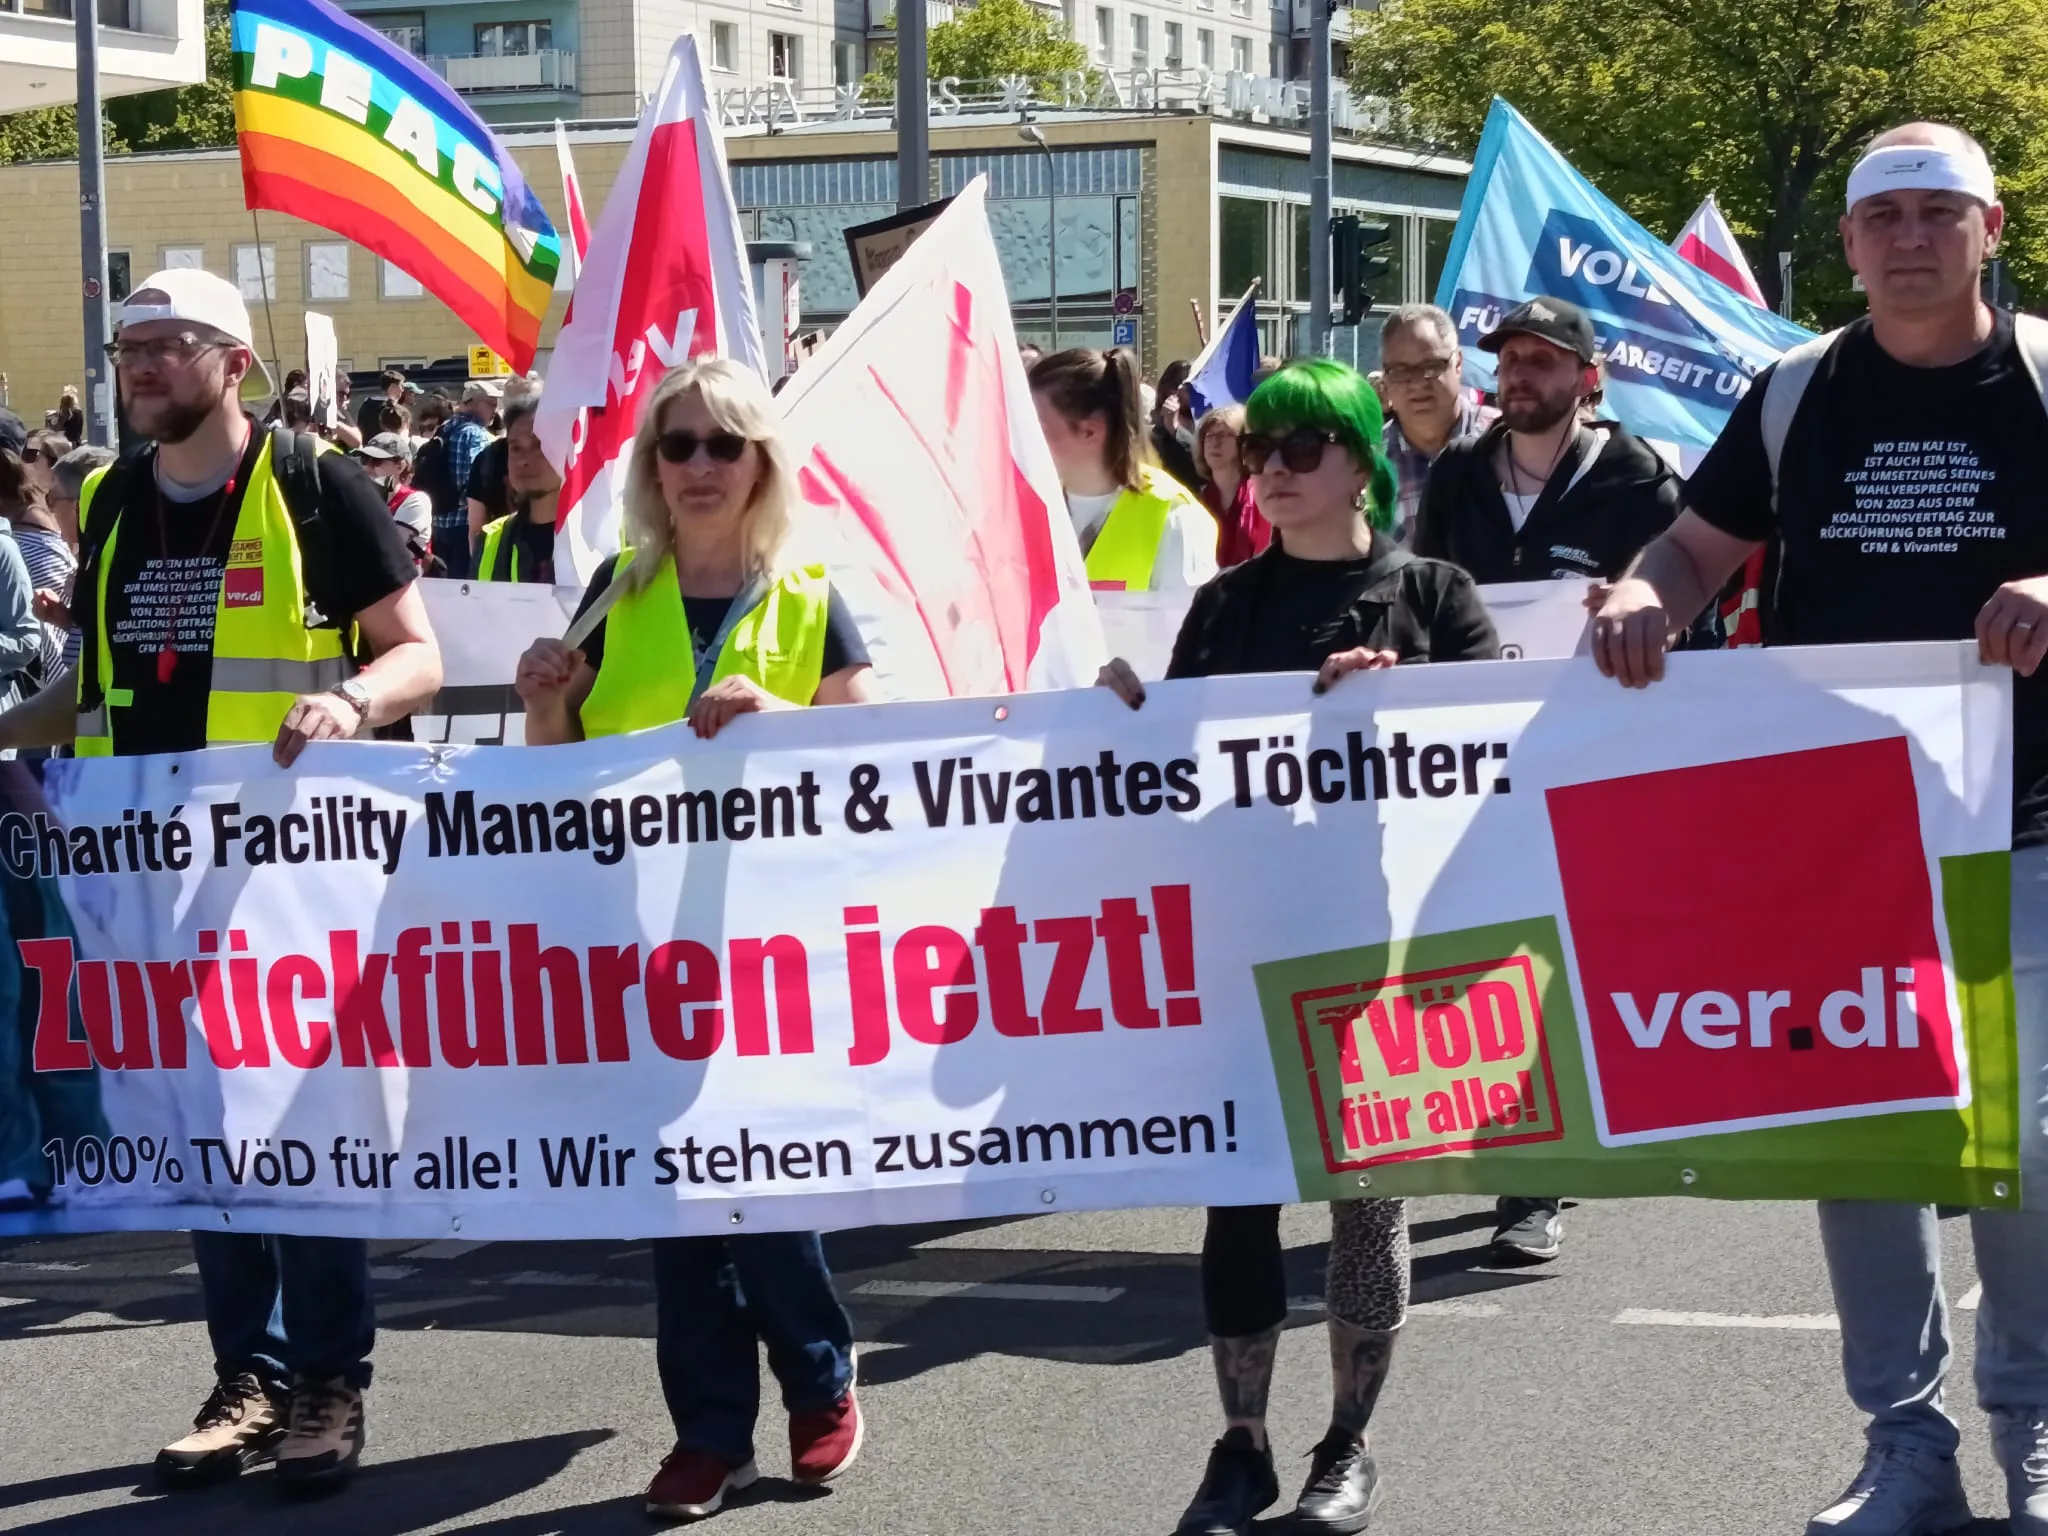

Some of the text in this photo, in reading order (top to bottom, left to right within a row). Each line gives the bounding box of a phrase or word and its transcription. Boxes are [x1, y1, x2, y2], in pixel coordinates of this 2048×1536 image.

[717, 82, 801, 127] KKA
[1062, 68, 1151, 109] BAR
[250, 23, 503, 215] PEAC
[1116, 326, 1128, 343] P
[1459, 305, 1500, 334] FÜ
[1609, 342, 1713, 388] ARBEIT
[1873, 442, 1894, 453] WO
[1897, 441, 1919, 452] EIN
[1922, 440, 1944, 451] KAI
[1947, 441, 1967, 453] IST
[1864, 454, 1979, 468] IST AUCH EIN WEG
[1844, 469, 1996, 482] ZUR UMSETZUNG SEINES
[1855, 482, 1980, 495] WAHLVERSPRECHEN
[1855, 496, 1975, 509] VON 2023 AUS DEM
[1831, 511, 1995, 524] KOALITIONSVERTRAG ZUR
[1819, 523, 2006, 539] RÜCKFÜHRUNG DER TÖCHTER
[1860, 541, 1958, 553] CFM & Vivantes
[146, 560, 163, 569] WO
[201, 557, 218, 566] IST
[138, 571, 154, 581] IST
[202, 568, 225, 578] WEG
[123, 584, 141, 593] ZUR
[204, 580, 221, 590] SEI
[226, 591, 262, 602] ver.di
[130, 607, 152, 617] VON
[178, 606, 198, 615] AUS
[178, 630, 197, 640] DER
[200, 628, 214, 639] TÖ
[138, 643, 156, 653] CFM
[2, 730, 1512, 879] Charité Facility Management & Vivantes Töchter:
[16, 883, 1202, 1073] Zurückführen jetzt!
[1611, 966, 1921, 1051] ver.di
[1316, 980, 1526, 1085] TVöD
[1338, 1069, 1539, 1150] für alle!
[42, 1100, 1239, 1190] 100% TVöD für alle! Wir stehen zusammen!
